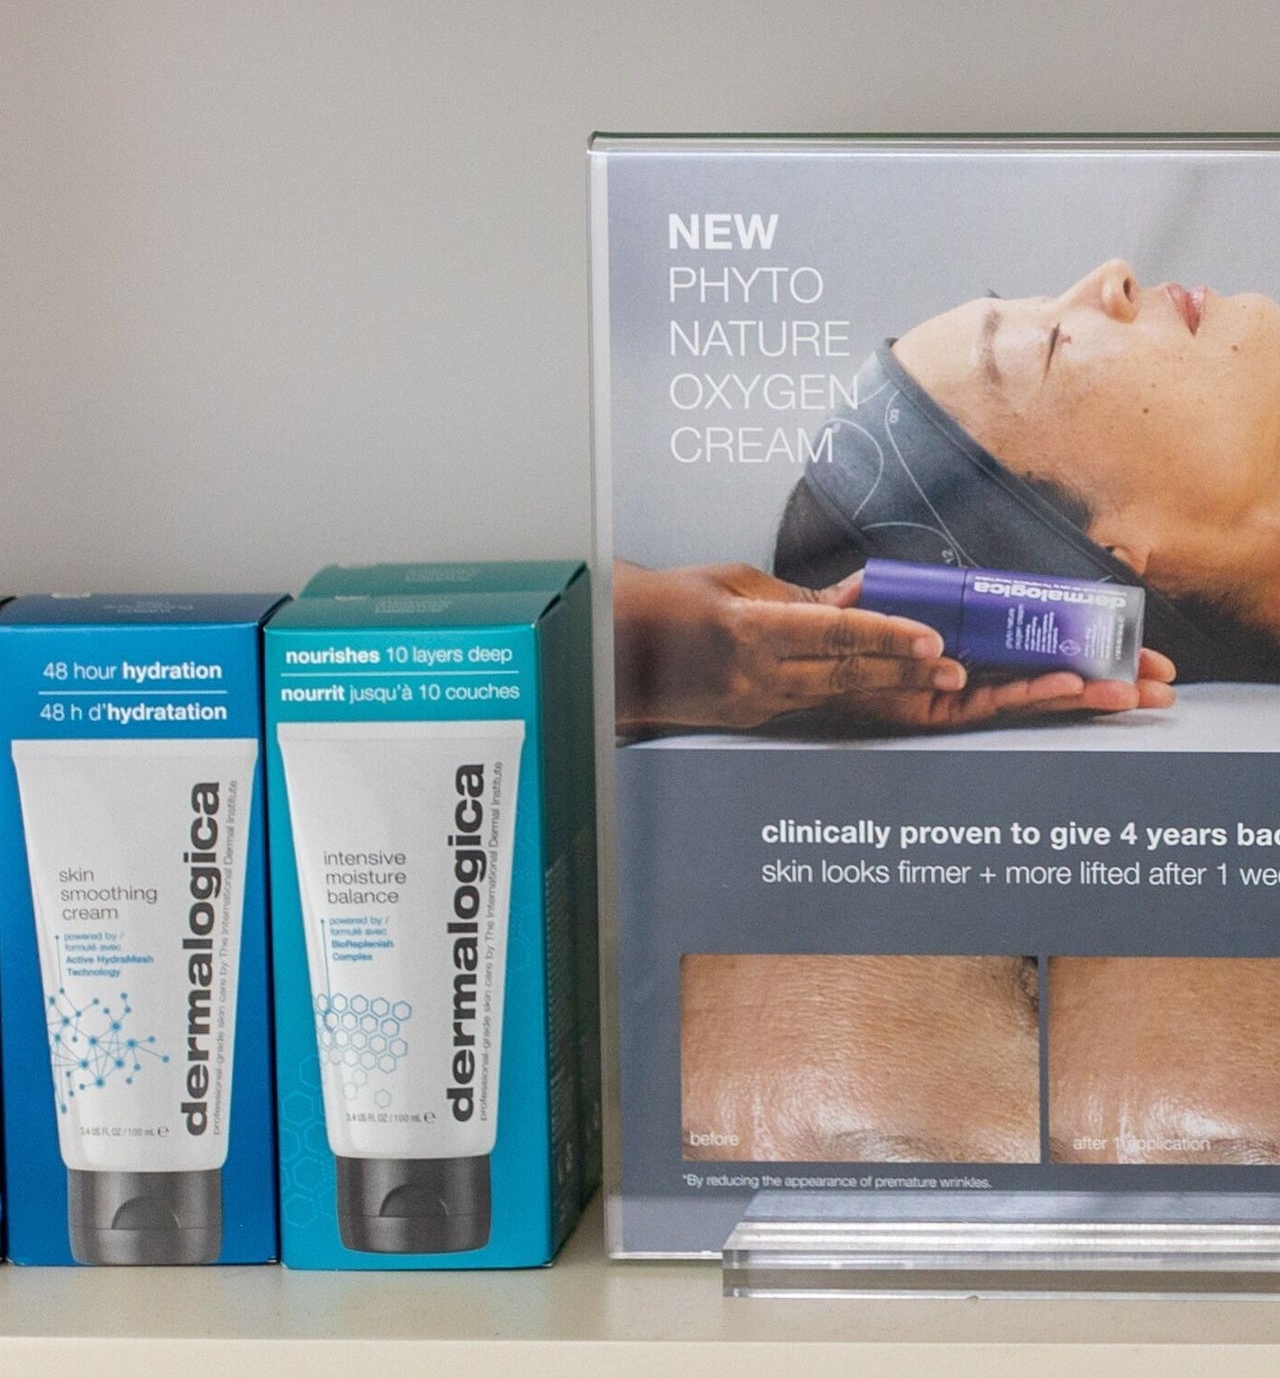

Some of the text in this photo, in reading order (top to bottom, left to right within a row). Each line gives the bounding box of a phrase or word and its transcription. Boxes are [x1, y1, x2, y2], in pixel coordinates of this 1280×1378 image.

[668, 214, 778, 250] NEW
[670, 267, 823, 303] PHYTO
[670, 321, 850, 356] NATURE
[670, 374, 858, 410] OXYGEN
[671, 427, 832, 463] CREAM
[286, 647, 512, 665] nourishes 10 layers deep
[43, 662, 222, 683] 48 hour hydration
[762, 820, 890, 849] clinically
[900, 827, 1001, 849] proven
[1011, 825, 1040, 845] to
[1051, 824, 1110, 850] give
[1120, 824, 1136, 846] 4
[1146, 829, 1228, 850] years
[324, 851, 406, 865] intensive
[59, 868, 94, 882] skin
[326, 870, 406, 884] moisture
[762, 860, 812, 883] skin
[822, 860, 889, 884] looks
[898, 861, 970, 884] firmer
[1006, 866, 1072, 885] more
[1080, 862, 1140, 886] lifted
[1149, 862, 1206, 886] after
[1218, 864, 1226, 886] 1
[60, 886, 157, 903] smoothing
[327, 889, 399, 904] balance
[62, 906, 118, 920] cream
[446, 763, 487, 1122] dermalogica
[181, 781, 222, 1136] dermalogica
